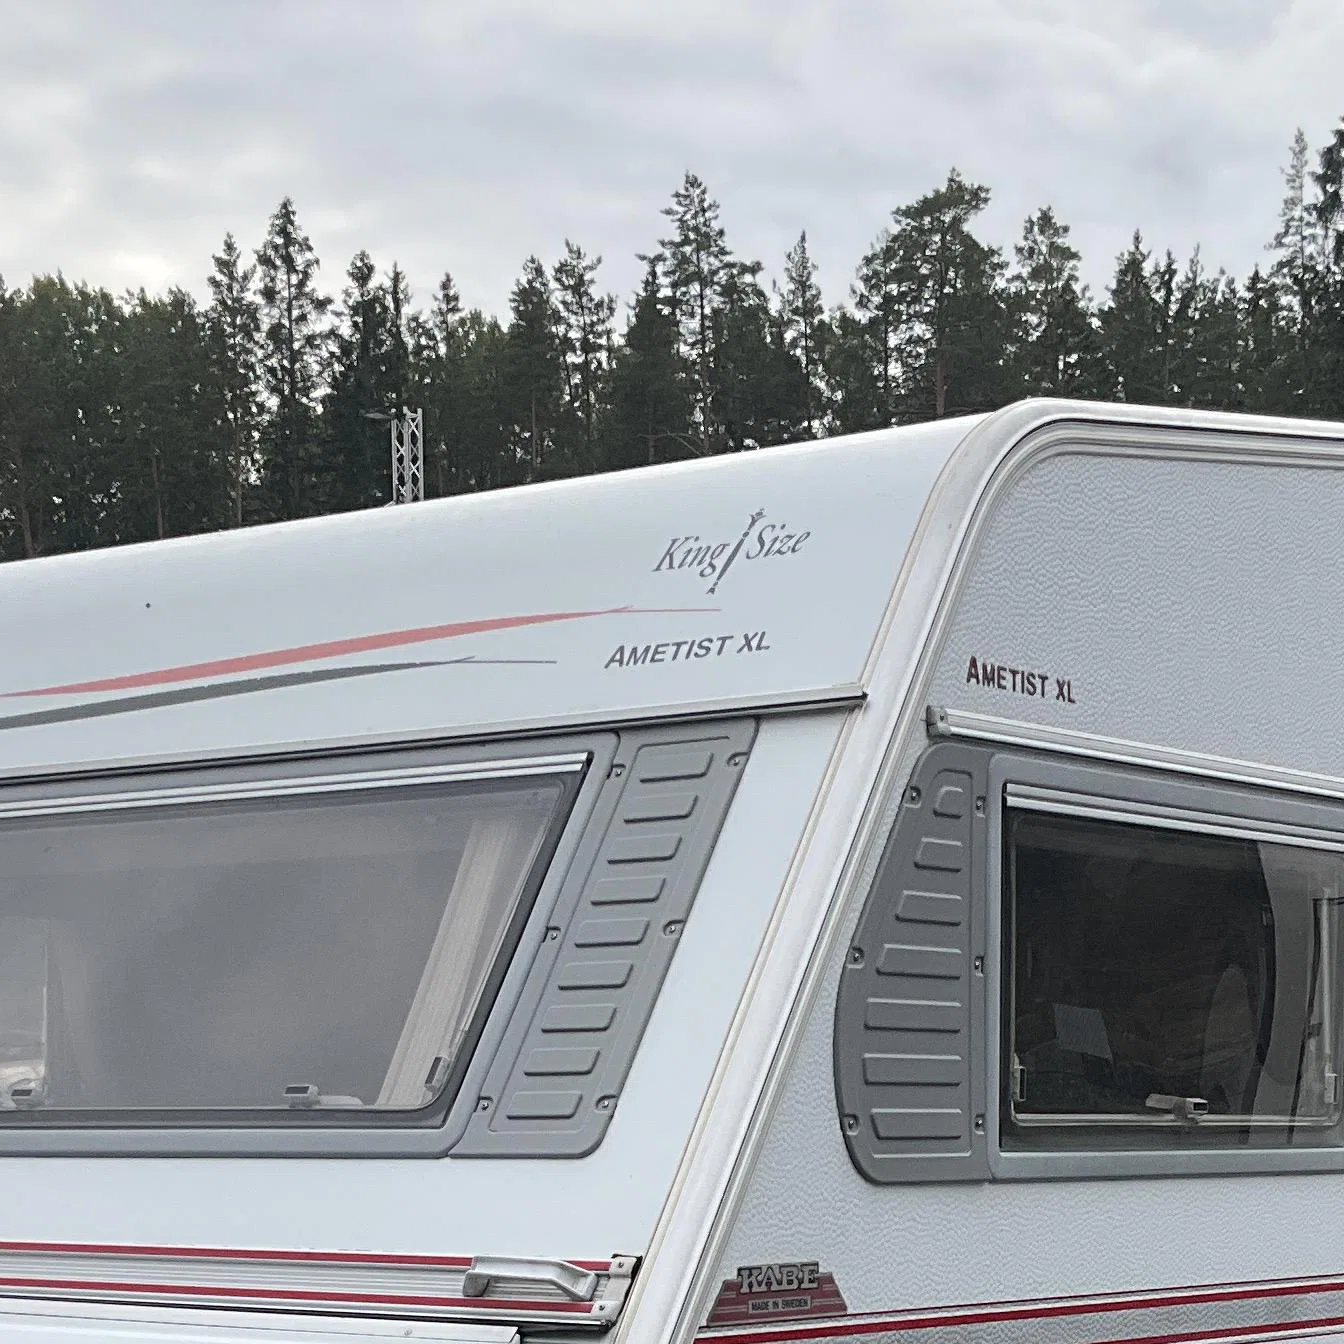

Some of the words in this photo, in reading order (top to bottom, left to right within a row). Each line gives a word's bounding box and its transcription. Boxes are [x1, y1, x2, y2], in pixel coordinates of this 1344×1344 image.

[652, 536, 732, 578] King
[745, 523, 811, 560] Size
[604, 634, 734, 669] AMETIST
[736, 631, 771, 654] XL
[1055, 678, 1076, 704] XL
[737, 1262, 819, 1293] KABE
